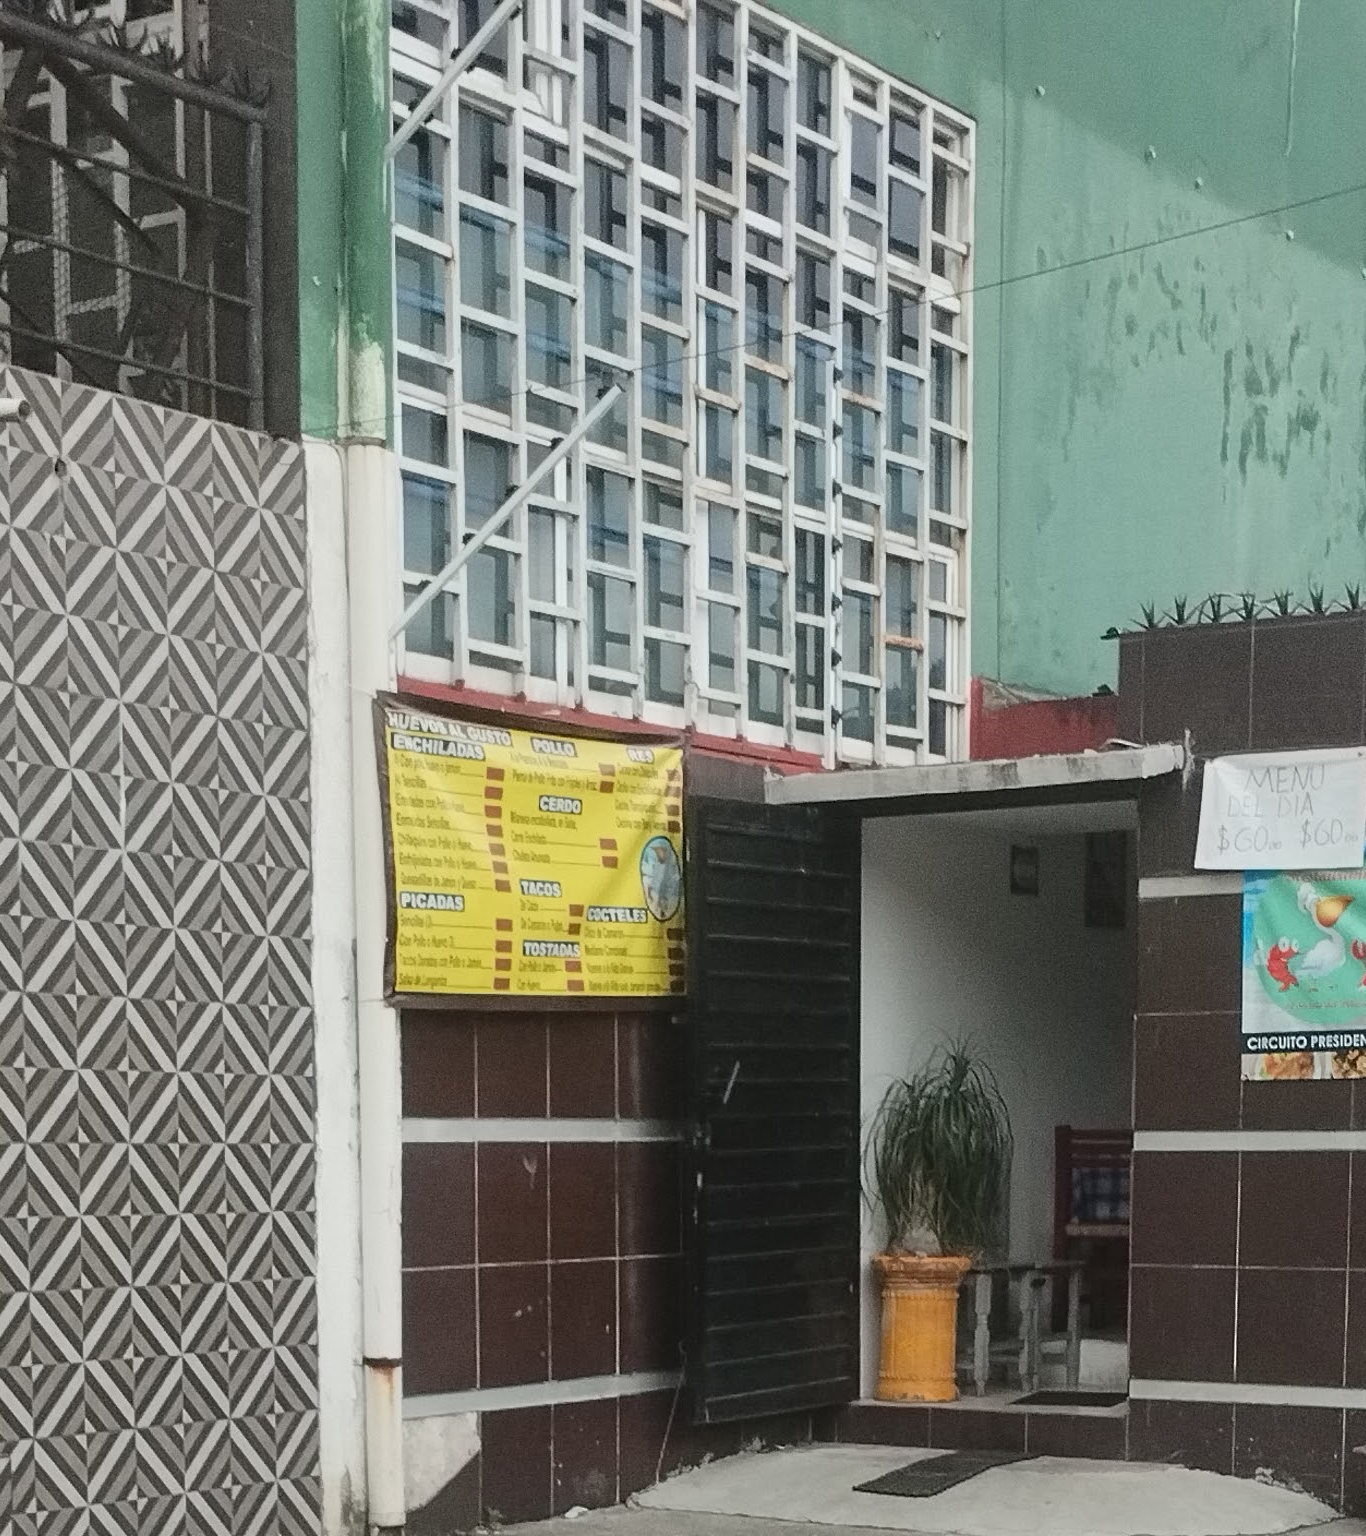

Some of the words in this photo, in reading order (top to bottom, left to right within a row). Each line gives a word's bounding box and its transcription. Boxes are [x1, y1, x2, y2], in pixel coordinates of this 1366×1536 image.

[466, 726, 512, 746] GUSTO
[393, 733, 485, 760] ENCHILADAS
[532, 739, 575, 757] POLLO
[628, 749, 654, 763] RES
[1243, 763, 1326, 794] MENU
[539, 796, 581, 814] CERDO
[1227, 794, 1266, 818] DEL
[1276, 791, 1315, 818] DIA
[521, 880, 562, 897] TACOS
[400, 892, 464, 911] PICADAS
[587, 907, 647, 923] COCTELES
[524, 942, 580, 957] TOSTADAS
[1246, 1035, 1307, 1050] CIRCUITO
